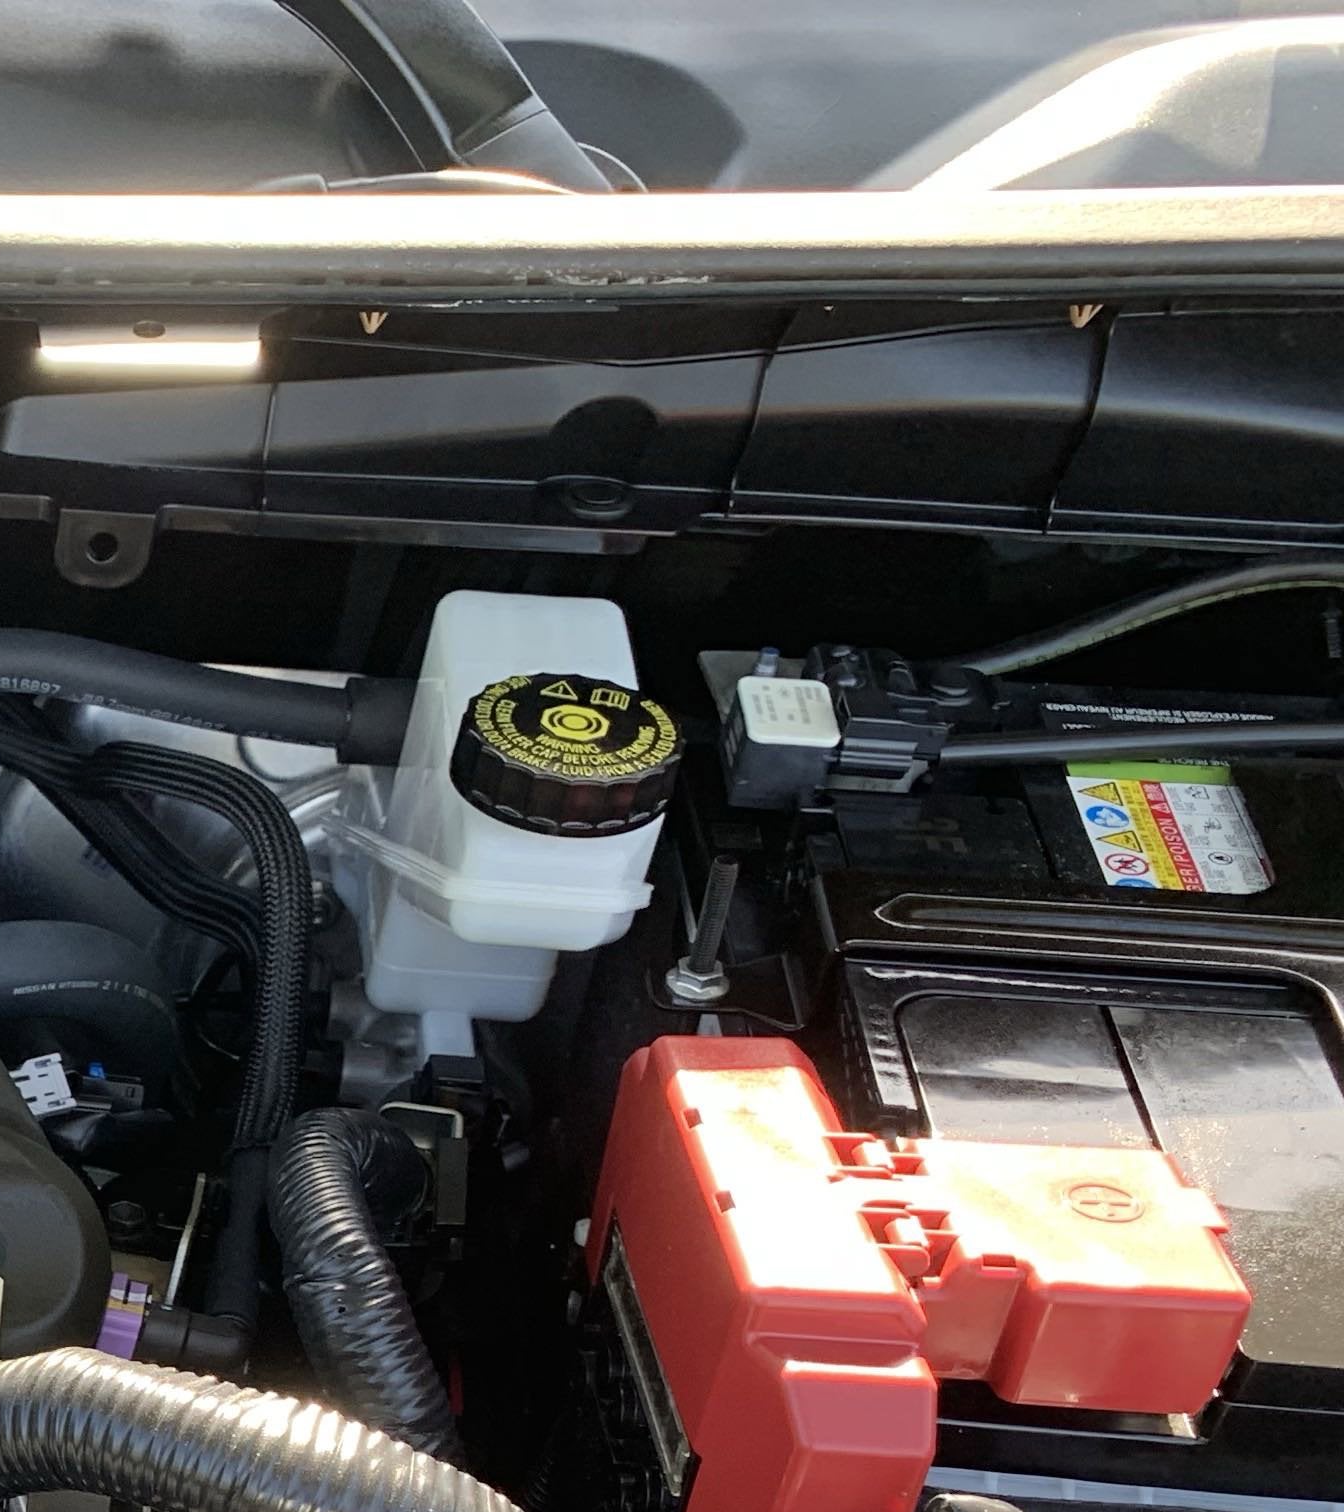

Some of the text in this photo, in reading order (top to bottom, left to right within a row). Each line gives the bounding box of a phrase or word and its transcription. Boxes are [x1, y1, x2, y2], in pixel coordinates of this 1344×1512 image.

[496, 699, 517, 722] CLEAN
[475, 719, 494, 731] OR
[640, 699, 677, 741] CONTAINER
[498, 723, 534, 749] FILLER
[535, 733, 600, 754] WARNING
[507, 747, 550, 770] BRAKE
[532, 745, 561, 760] CAP
[562, 752, 619, 766] BEFORE
[640, 740, 675, 767] SEALED
[552, 763, 595, 778] FLUID
[597, 763, 635, 777] FROM
[633, 760, 647, 771] A
